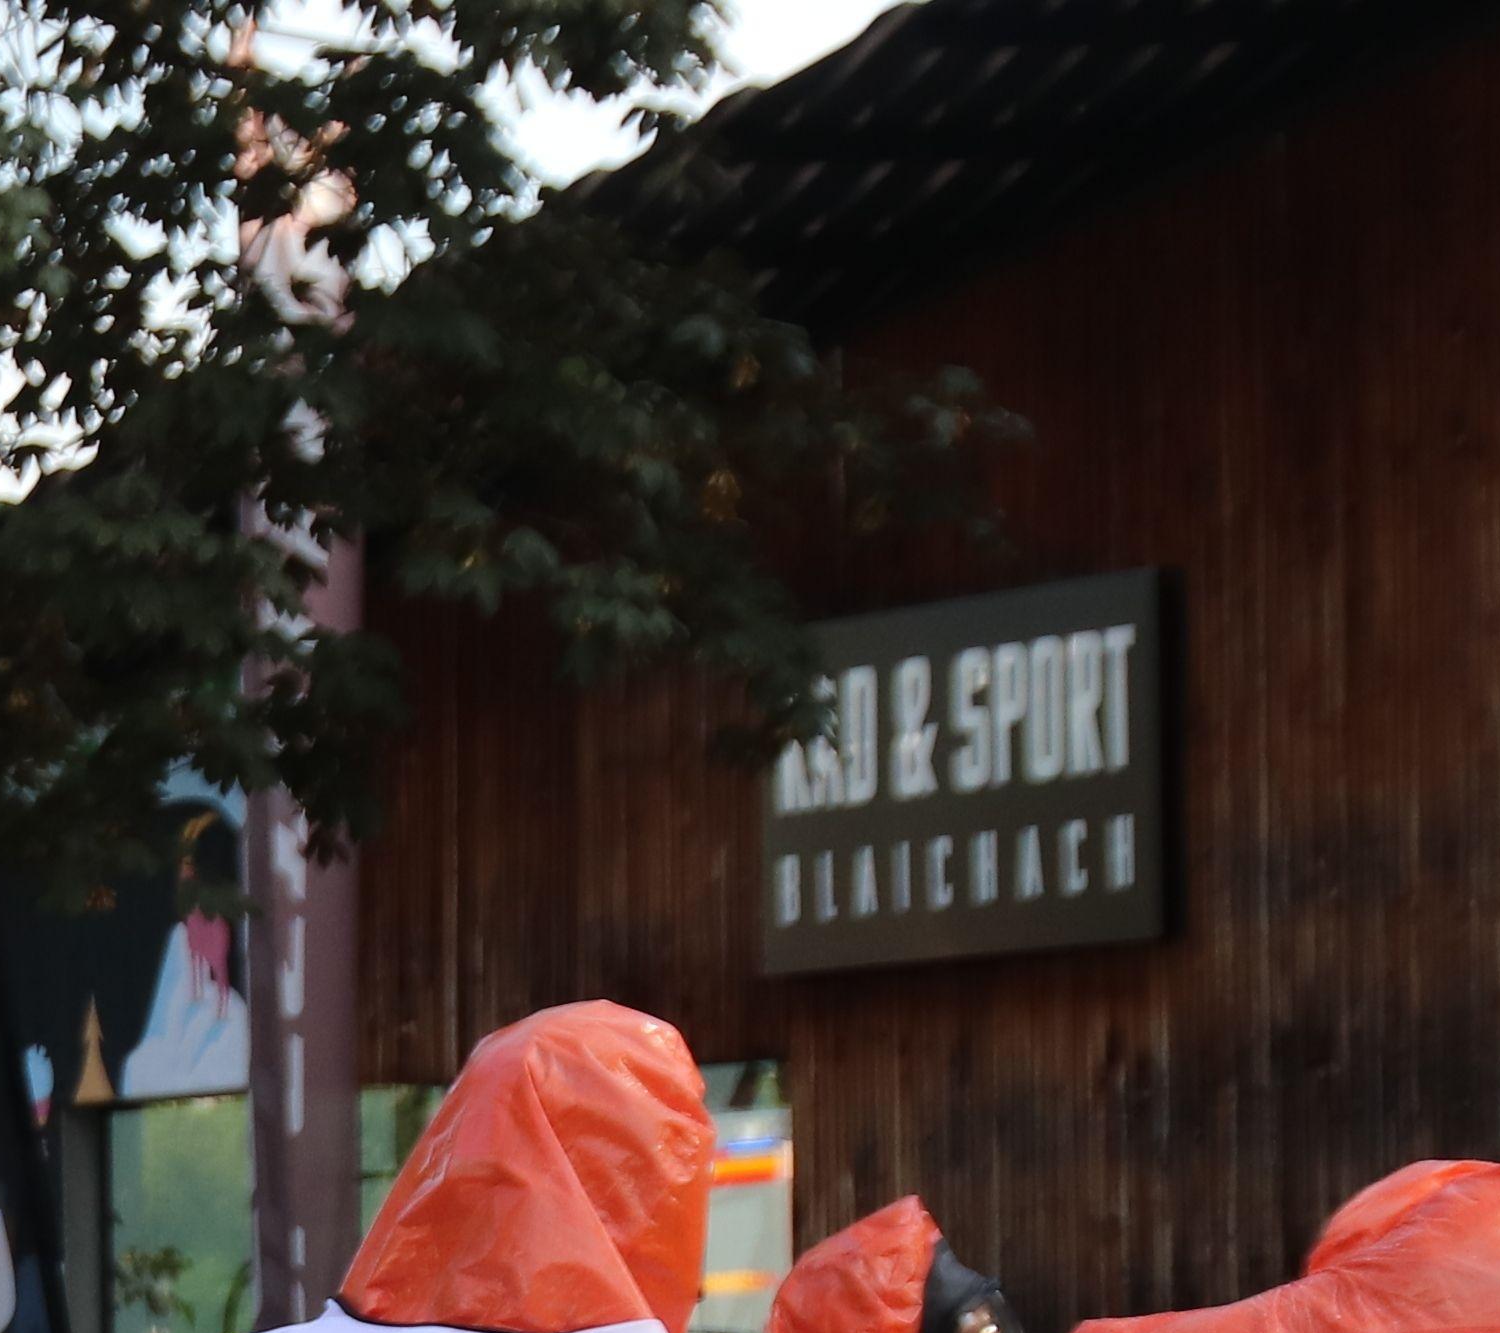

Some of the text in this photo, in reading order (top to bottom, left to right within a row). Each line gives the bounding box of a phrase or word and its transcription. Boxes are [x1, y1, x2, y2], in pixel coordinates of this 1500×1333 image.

[889, 655, 939, 797] &
[949, 623, 1137, 794] SPORT
[775, 813, 1136, 928] BLAICHACH
